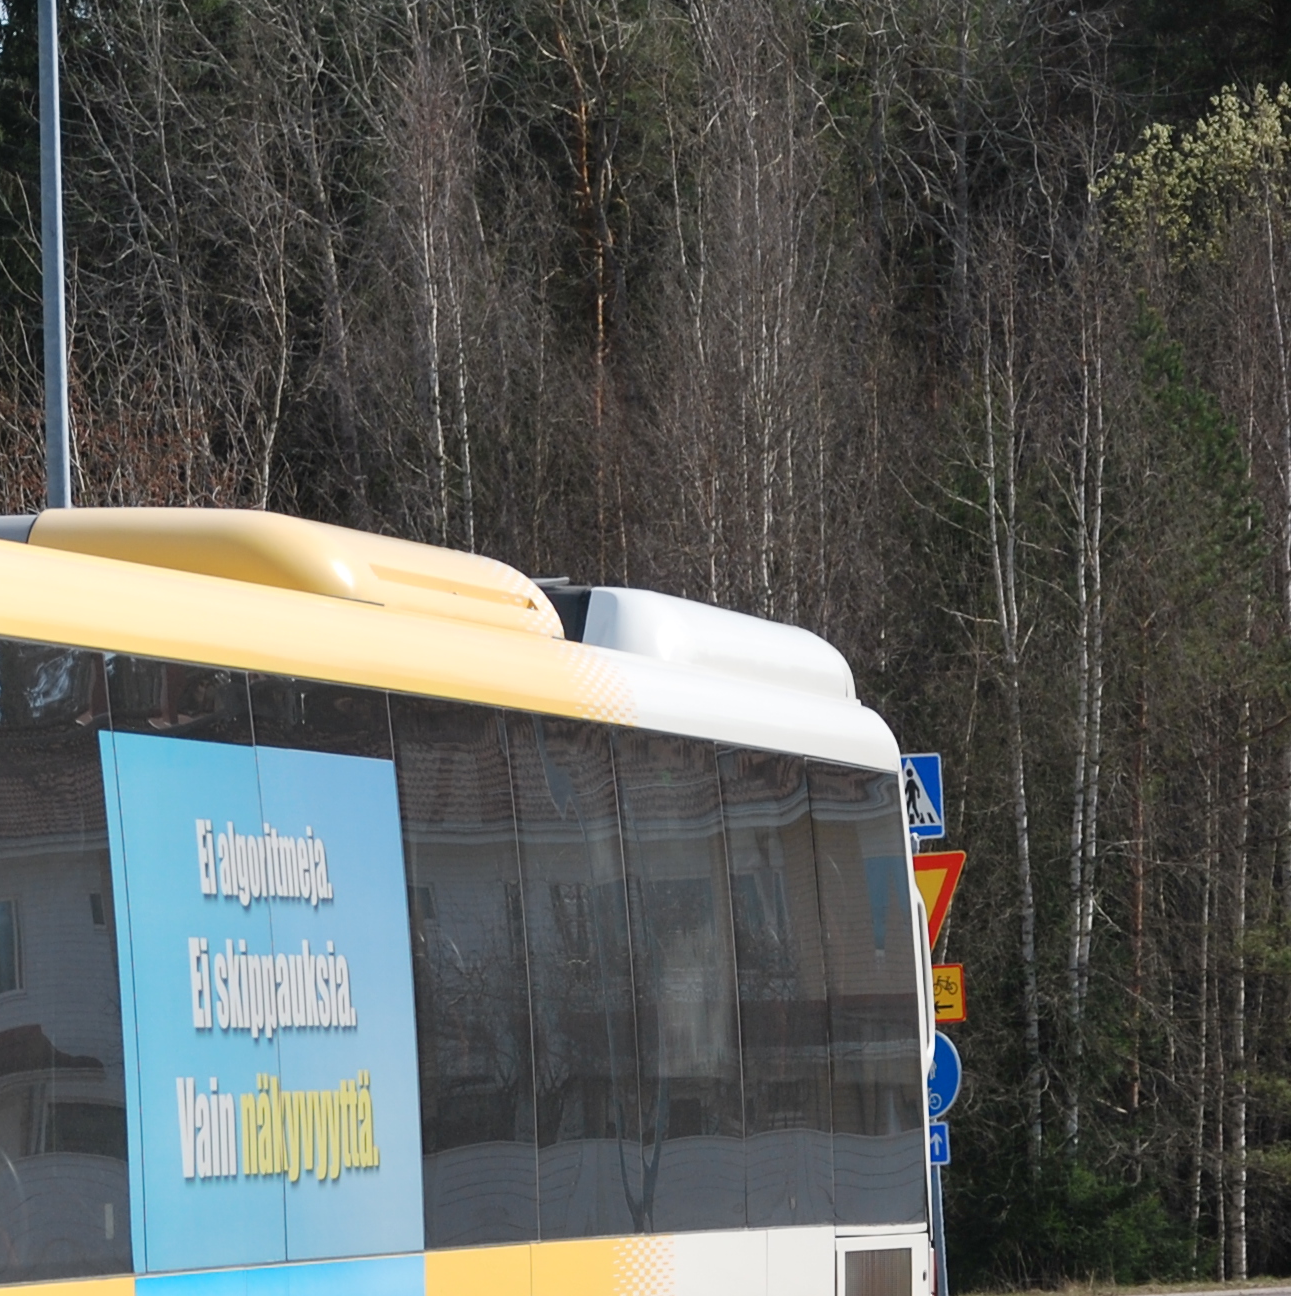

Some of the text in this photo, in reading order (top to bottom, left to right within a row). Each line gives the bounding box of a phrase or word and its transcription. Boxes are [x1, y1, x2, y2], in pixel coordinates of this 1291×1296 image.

[195, 818, 334, 907] Ei algoritmeja.
[187, 937, 358, 1039] Ei skippauksia.
[175, 1069, 381, 1183] Vain näkyvyyttä.
